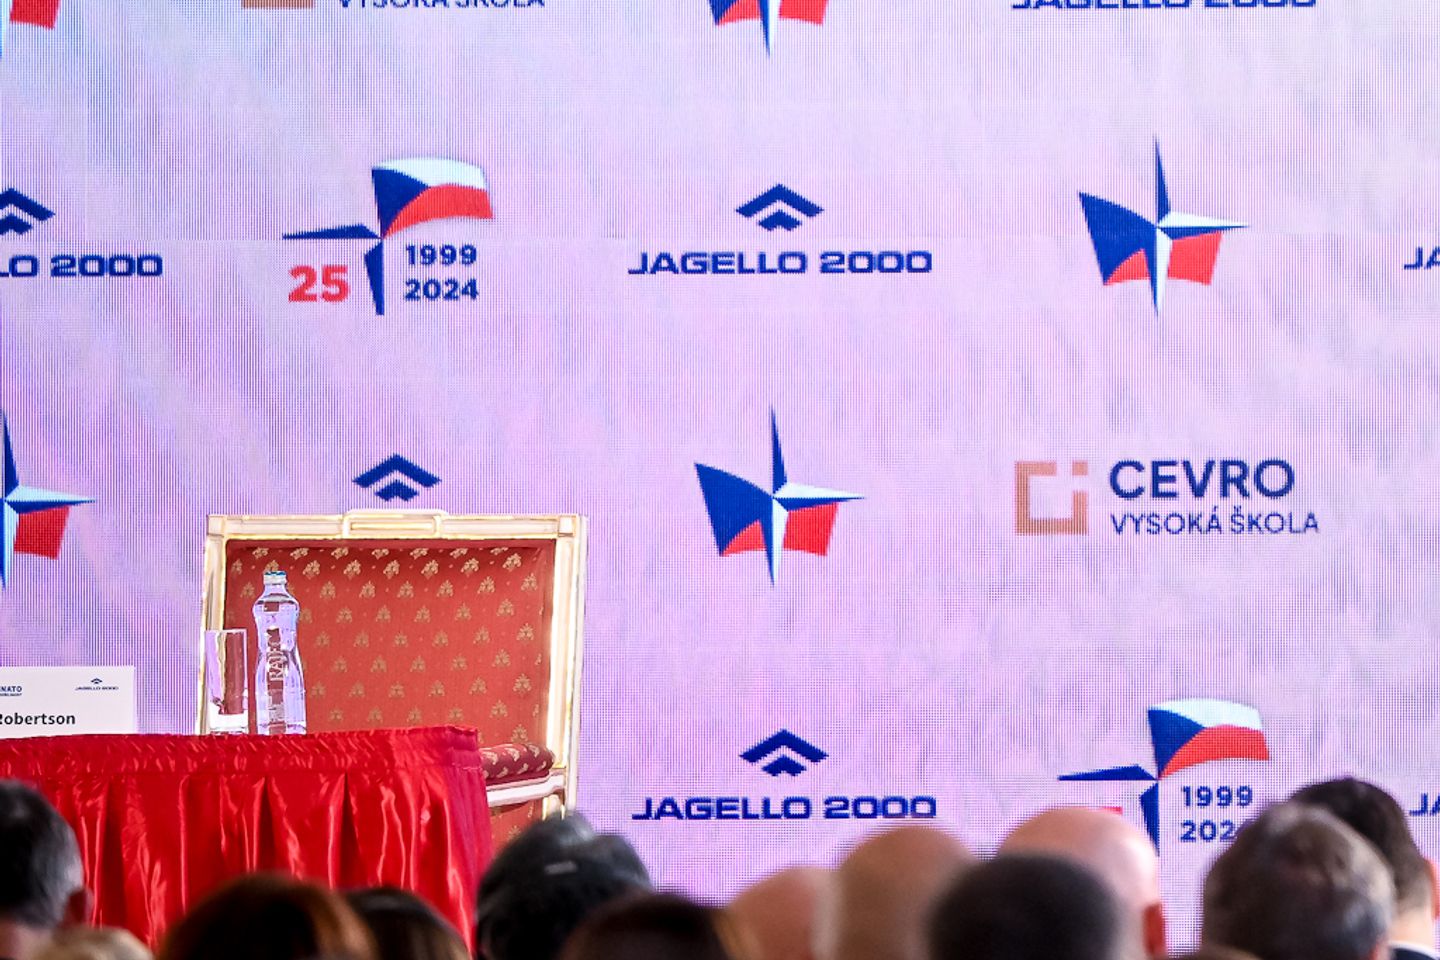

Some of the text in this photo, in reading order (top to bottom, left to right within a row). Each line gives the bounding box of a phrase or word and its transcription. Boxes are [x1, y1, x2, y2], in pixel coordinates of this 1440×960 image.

[50, 254, 163, 277] 2000
[406, 244, 478, 266] 1999
[628, 251, 933, 275] JAGELLO 2000
[288, 265, 351, 303] 25
[404, 278, 479, 301] 2024
[1110, 459, 1295, 500] CEVRO
[1111, 506, 1319, 535] VYSOKÁ ŠKOLA
[0, 712, 76, 725] obertson
[632, 796, 937, 820] JAGELLO 2000
[1182, 785, 1253, 808] 1999
[1180, 819, 1238, 842] 202
